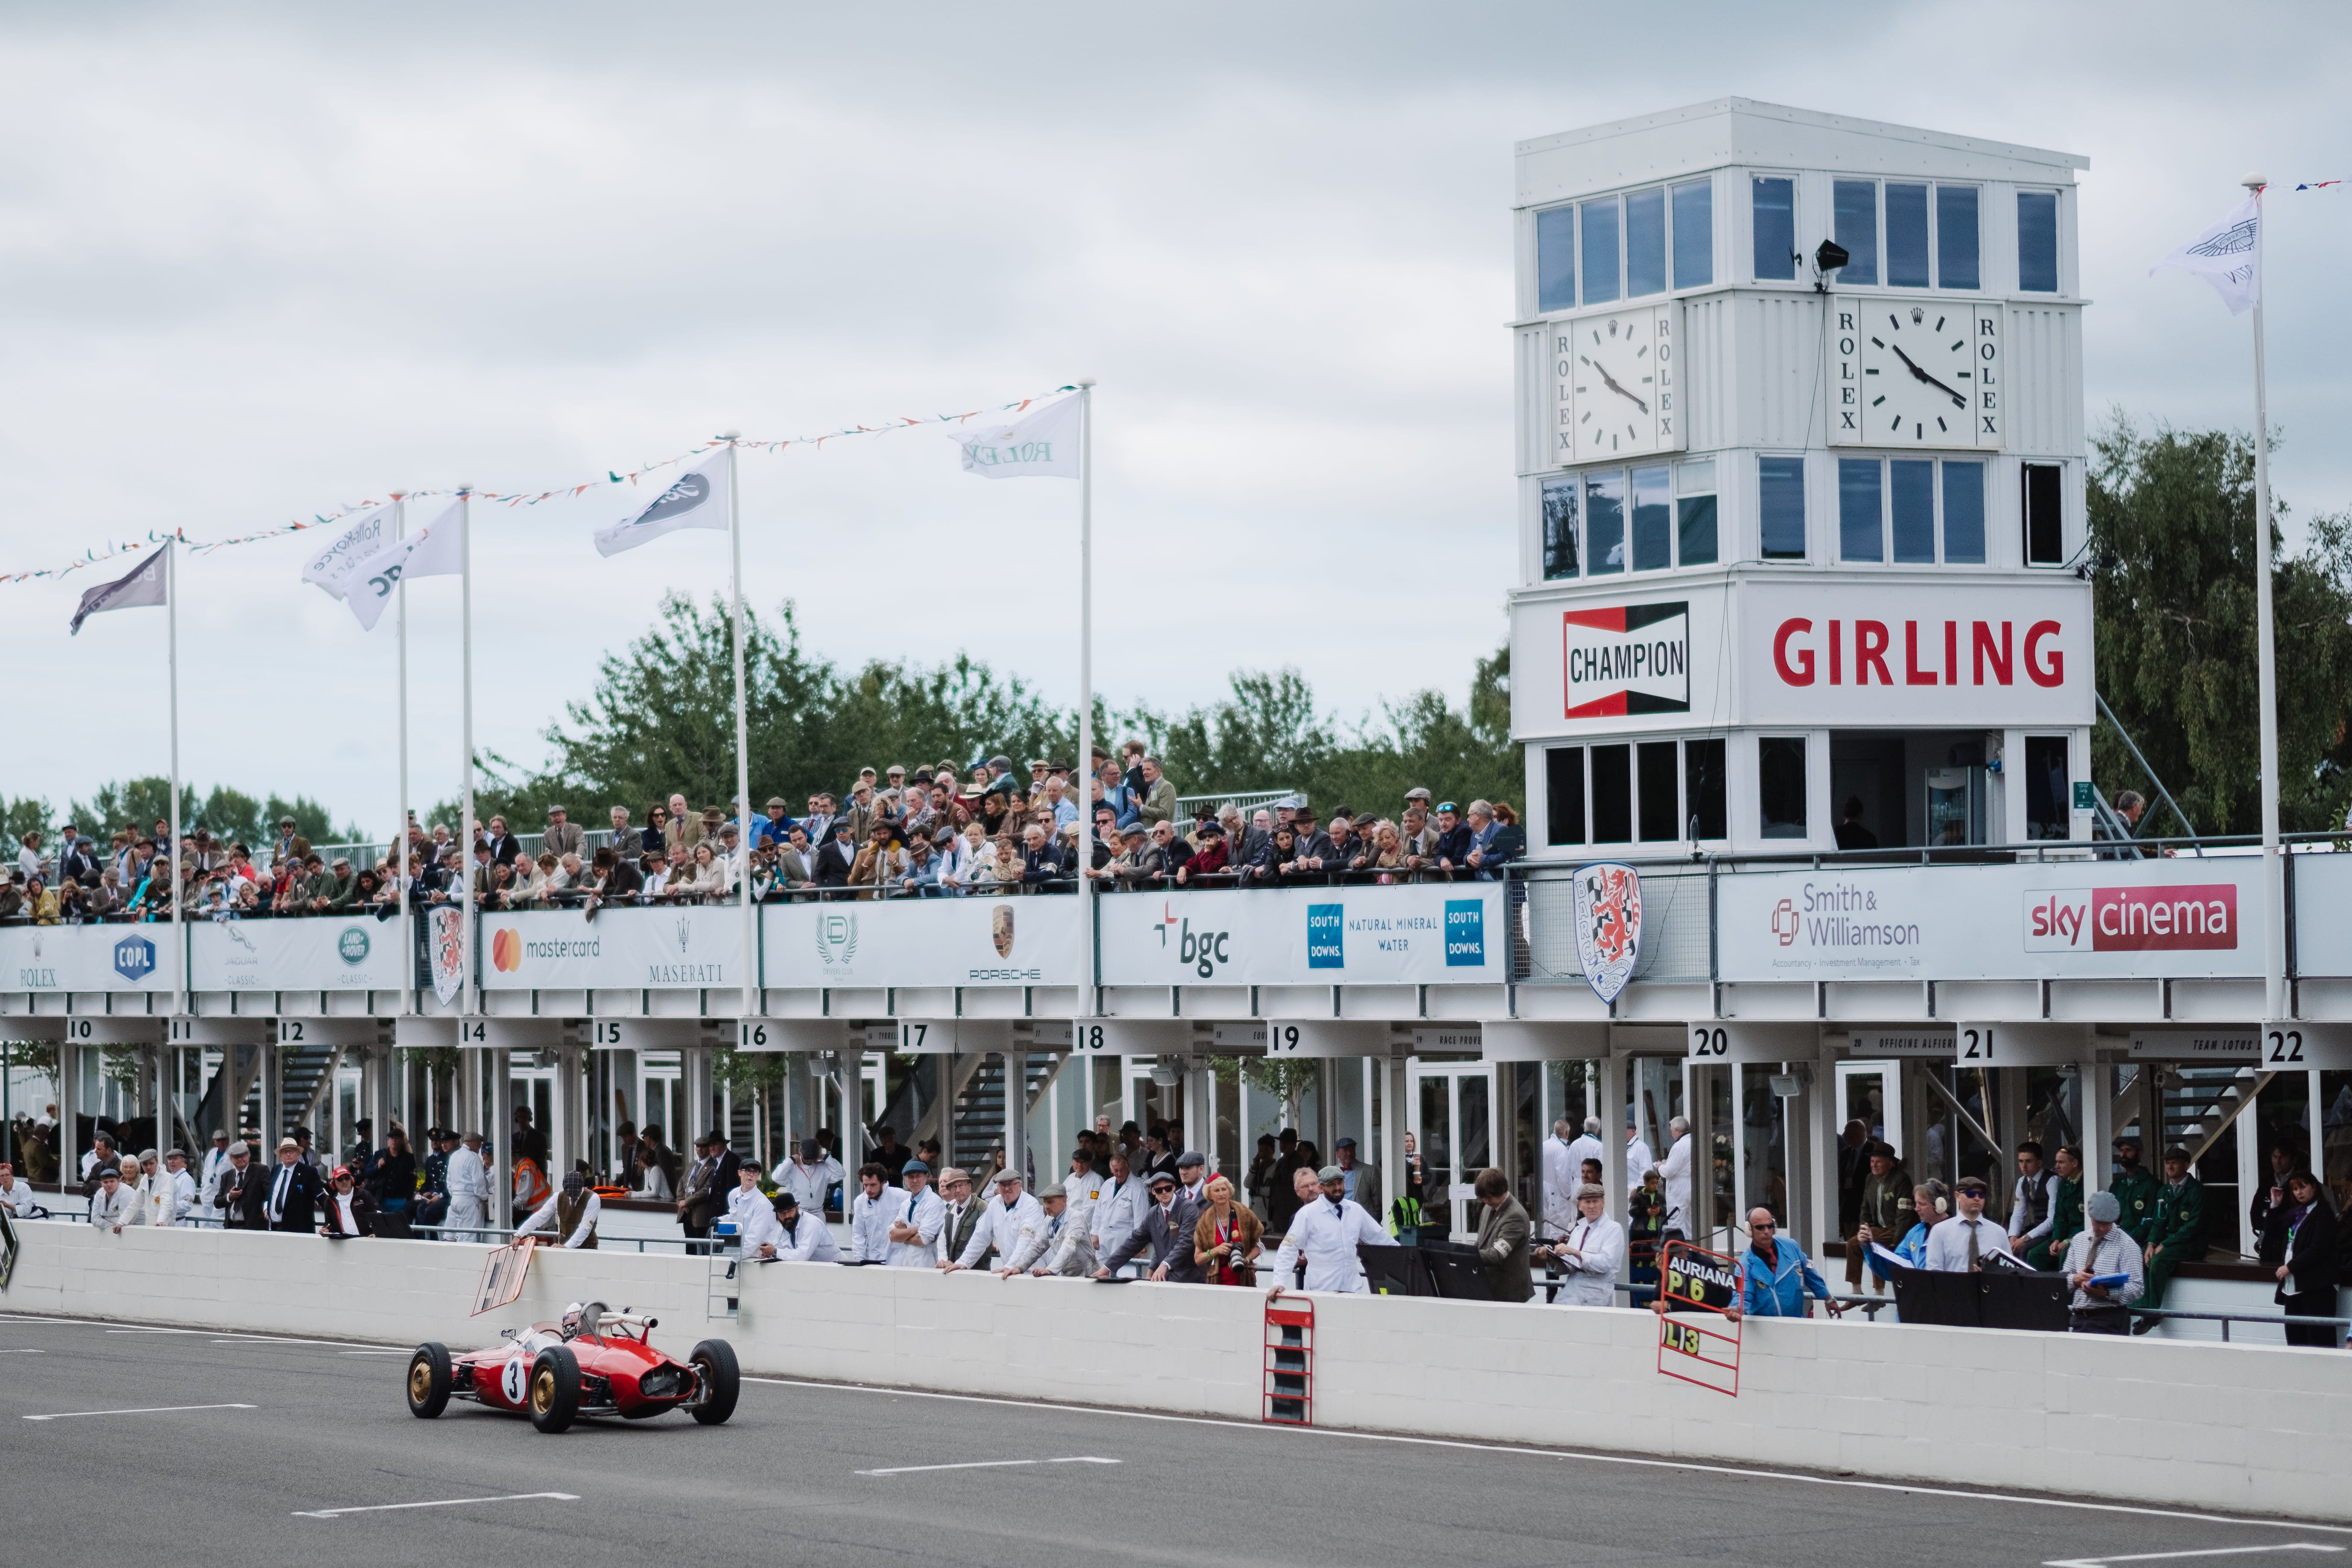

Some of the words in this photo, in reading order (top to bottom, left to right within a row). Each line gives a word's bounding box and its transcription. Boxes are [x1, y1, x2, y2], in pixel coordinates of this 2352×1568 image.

[1658, 320, 1672, 435] ROLEX
[1839, 313, 1856, 429] ROLEX
[1980, 319, 1997, 433] ROLEX
[1557, 337, 1571, 449] ROLEX
[1570, 640, 1684, 683] CHAMPION
[1773, 617, 2064, 688] GIRLING
[1803, 883, 1862, 912] Smith
[1866, 891, 1877, 911] &
[1310, 916, 1340, 928] SOUTH
[1349, 918, 1392, 931] NATURAL
[1396, 917, 1438, 930] MINERAL
[1448, 912, 1479, 924] SOUTH
[1575, 880, 1591, 962] BARC
[2032, 895, 2086, 946] sky
[2099, 892, 2227, 935] cinema
[344, 933, 360, 944] LAND
[1807, 917, 1919, 946] Williamson
[345, 944, 365, 956] ROVER
[526, 935, 600, 959] mastercard
[1180, 917, 1229, 979] bgc
[1378, 939, 1409, 951] WATER
[119, 947, 150, 967] COPL
[225, 957, 258, 965] JAGUAR
[1773, 958, 1811, 969] Accountancy
[1820, 958, 1856, 967] Investment
[1858, 958, 1901, 968] Management
[1909, 957, 1920, 966] Tax
[21, 969, 56, 987] ROLEX
[649, 964, 723, 983] MASERATI
[970, 969, 1041, 980] PORSCHE
[71, 1021, 91, 1038] 10
[173, 1022, 191, 1039] 11
[282, 1022, 303, 1041] 12
[464, 1022, 486, 1042] 14
[598, 1023, 620, 1043] 15
[743, 1024, 767, 1046] 16
[903, 1024, 928, 1047] 17
[1079, 1025, 1104, 1049] 18
[1273, 1026, 1299, 1051] 19
[1417, 1036, 1422, 1044] 19
[1439, 1036, 1456, 1044] RACE
[1695, 1028, 1728, 1056] 20
[1854, 1038, 1861, 1047] 20
[1879, 1038, 1918, 1048] OFFICINE
[1964, 1030, 1993, 1059] 21
[2134, 1041, 2143, 1050] 21
[2193, 1040, 2218, 1050] TEAM
[2223, 1040, 2252, 1050] LOTUS
[2269, 1031, 2303, 1062] 22
[1669, 1256, 1736, 1290] AURIANA
[1667, 1269, 1682, 1293] P
[1690, 1278, 1705, 1301] 6
[1666, 1321, 1678, 1348] L
[1685, 1329, 1699, 1353] 3
[509, 1361, 518, 1399] 3
